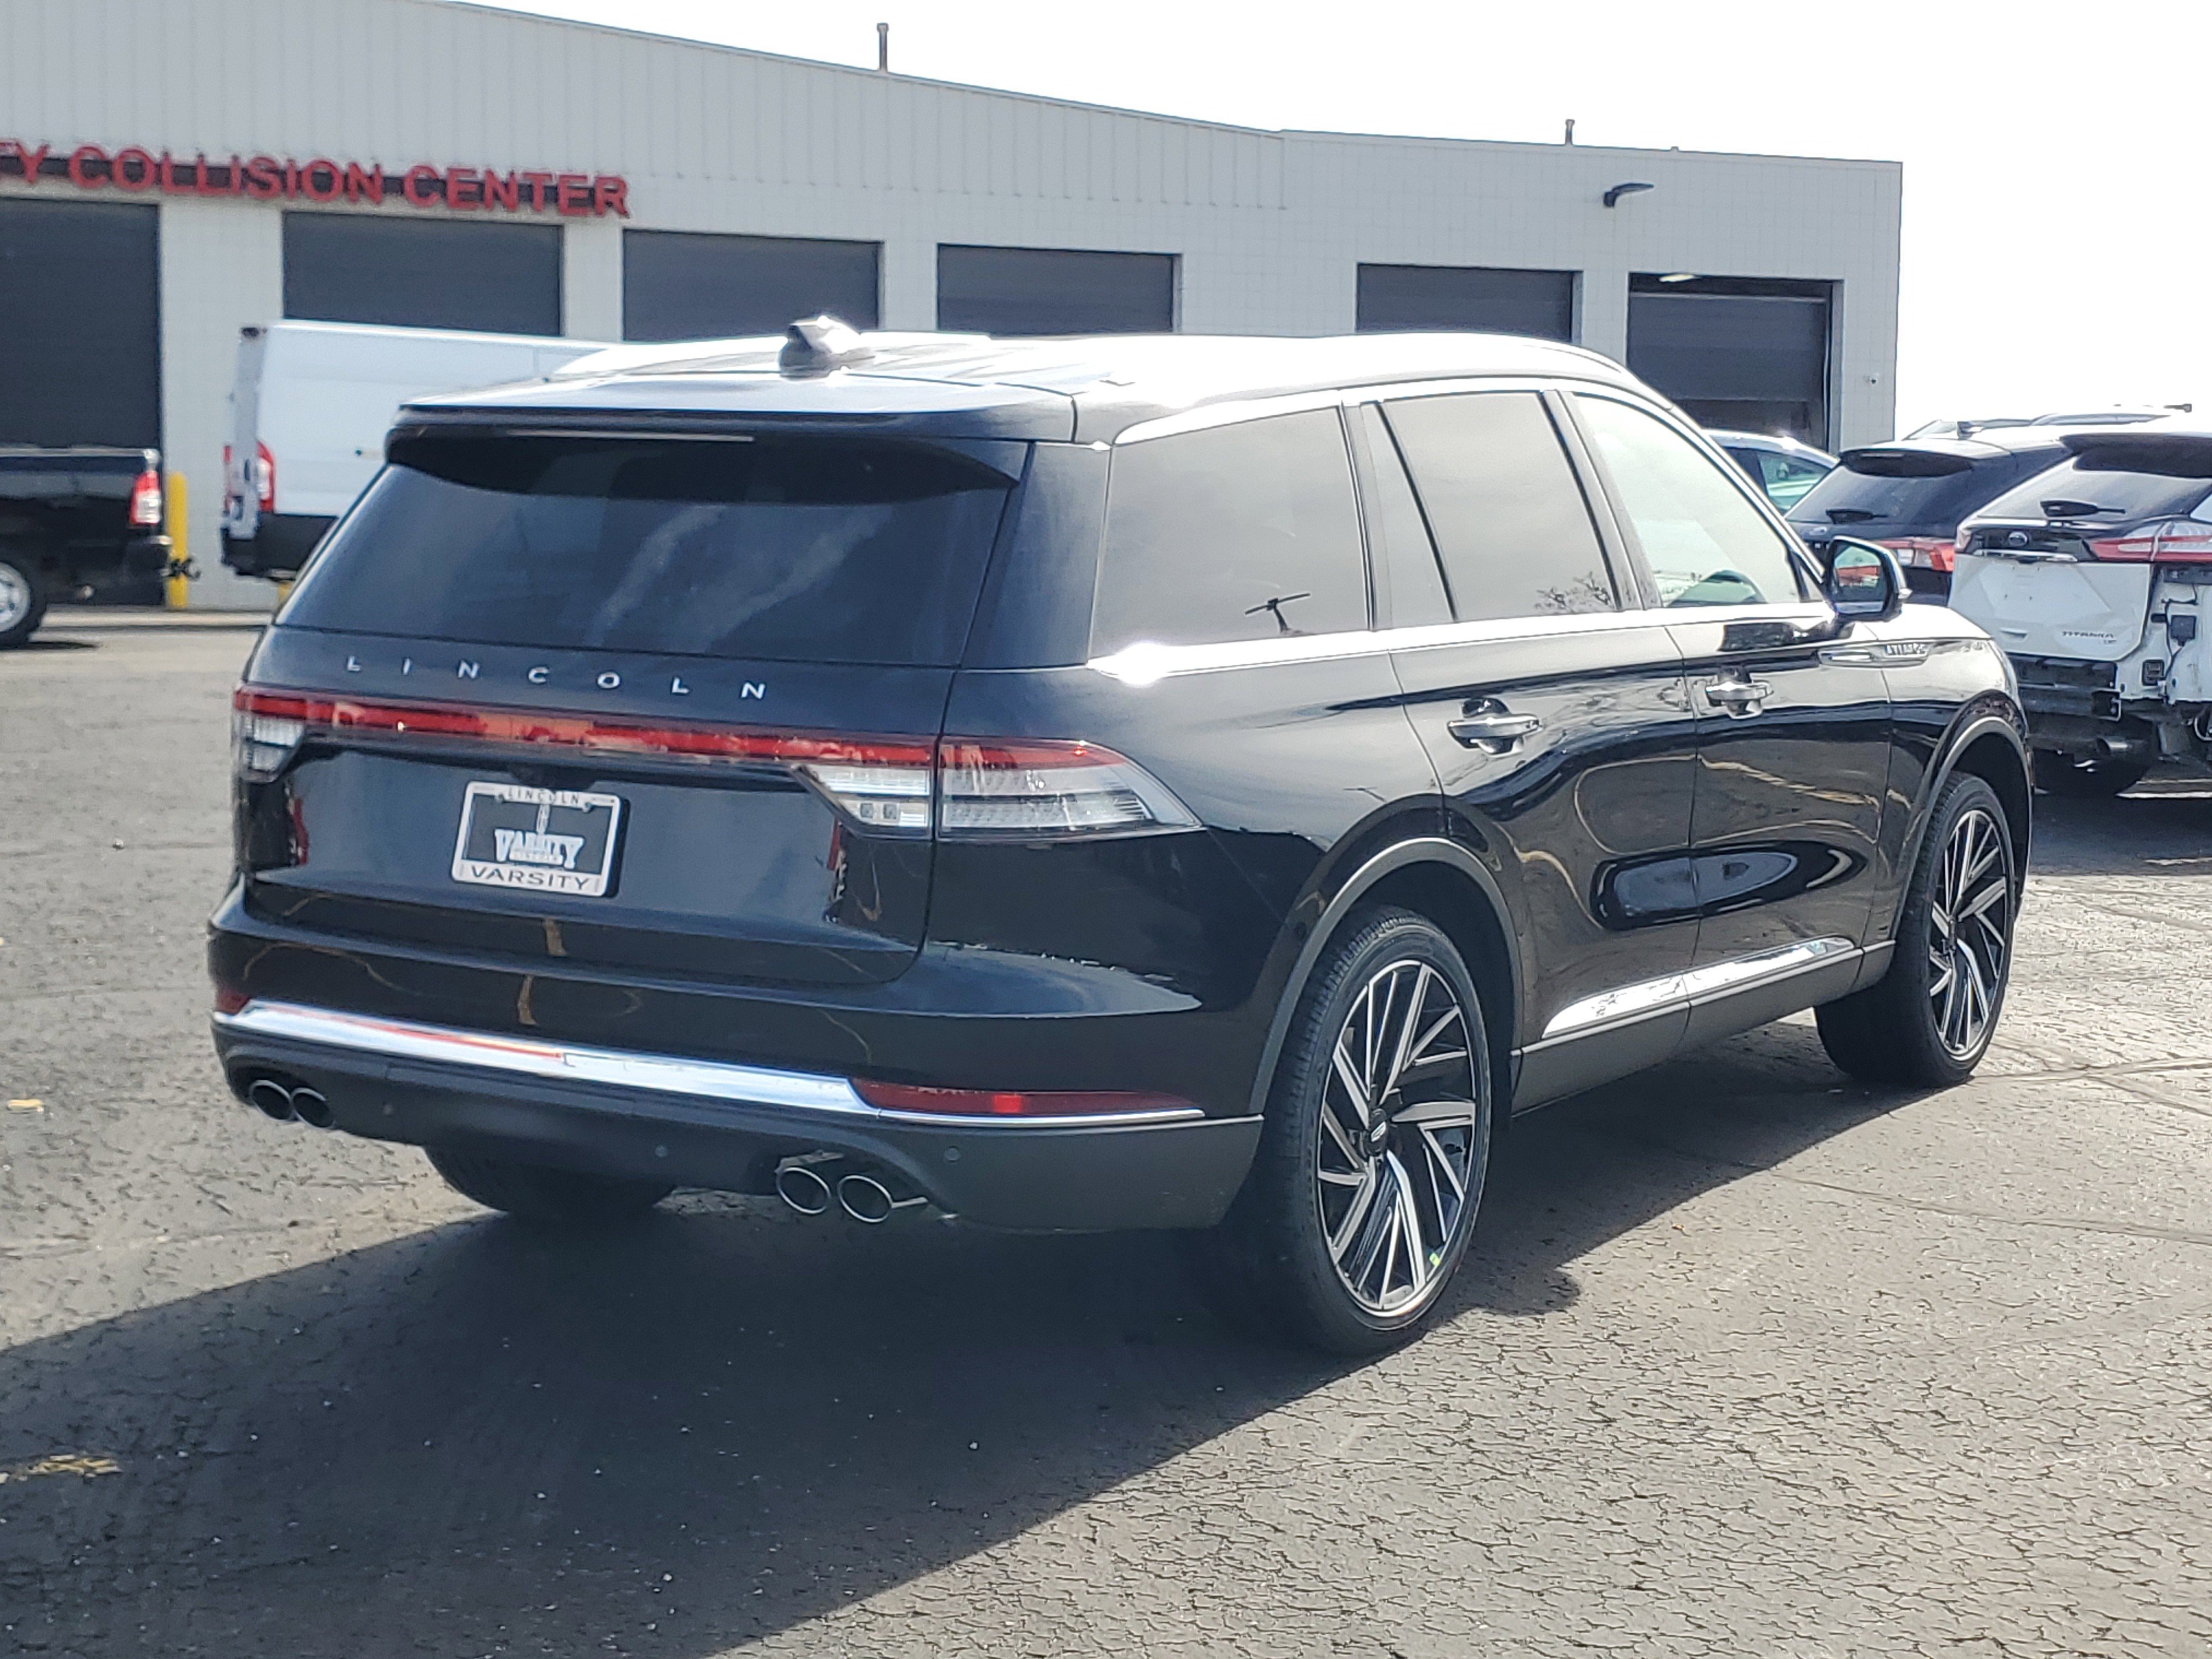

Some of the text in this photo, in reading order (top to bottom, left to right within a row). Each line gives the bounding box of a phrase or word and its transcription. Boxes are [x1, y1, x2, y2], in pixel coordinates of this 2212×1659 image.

[69, 146, 383, 205] COLLISION
[403, 165, 629, 218] CENTER
[347, 656, 766, 701] LINCOLN
[471, 865, 589, 890] VARSITY
